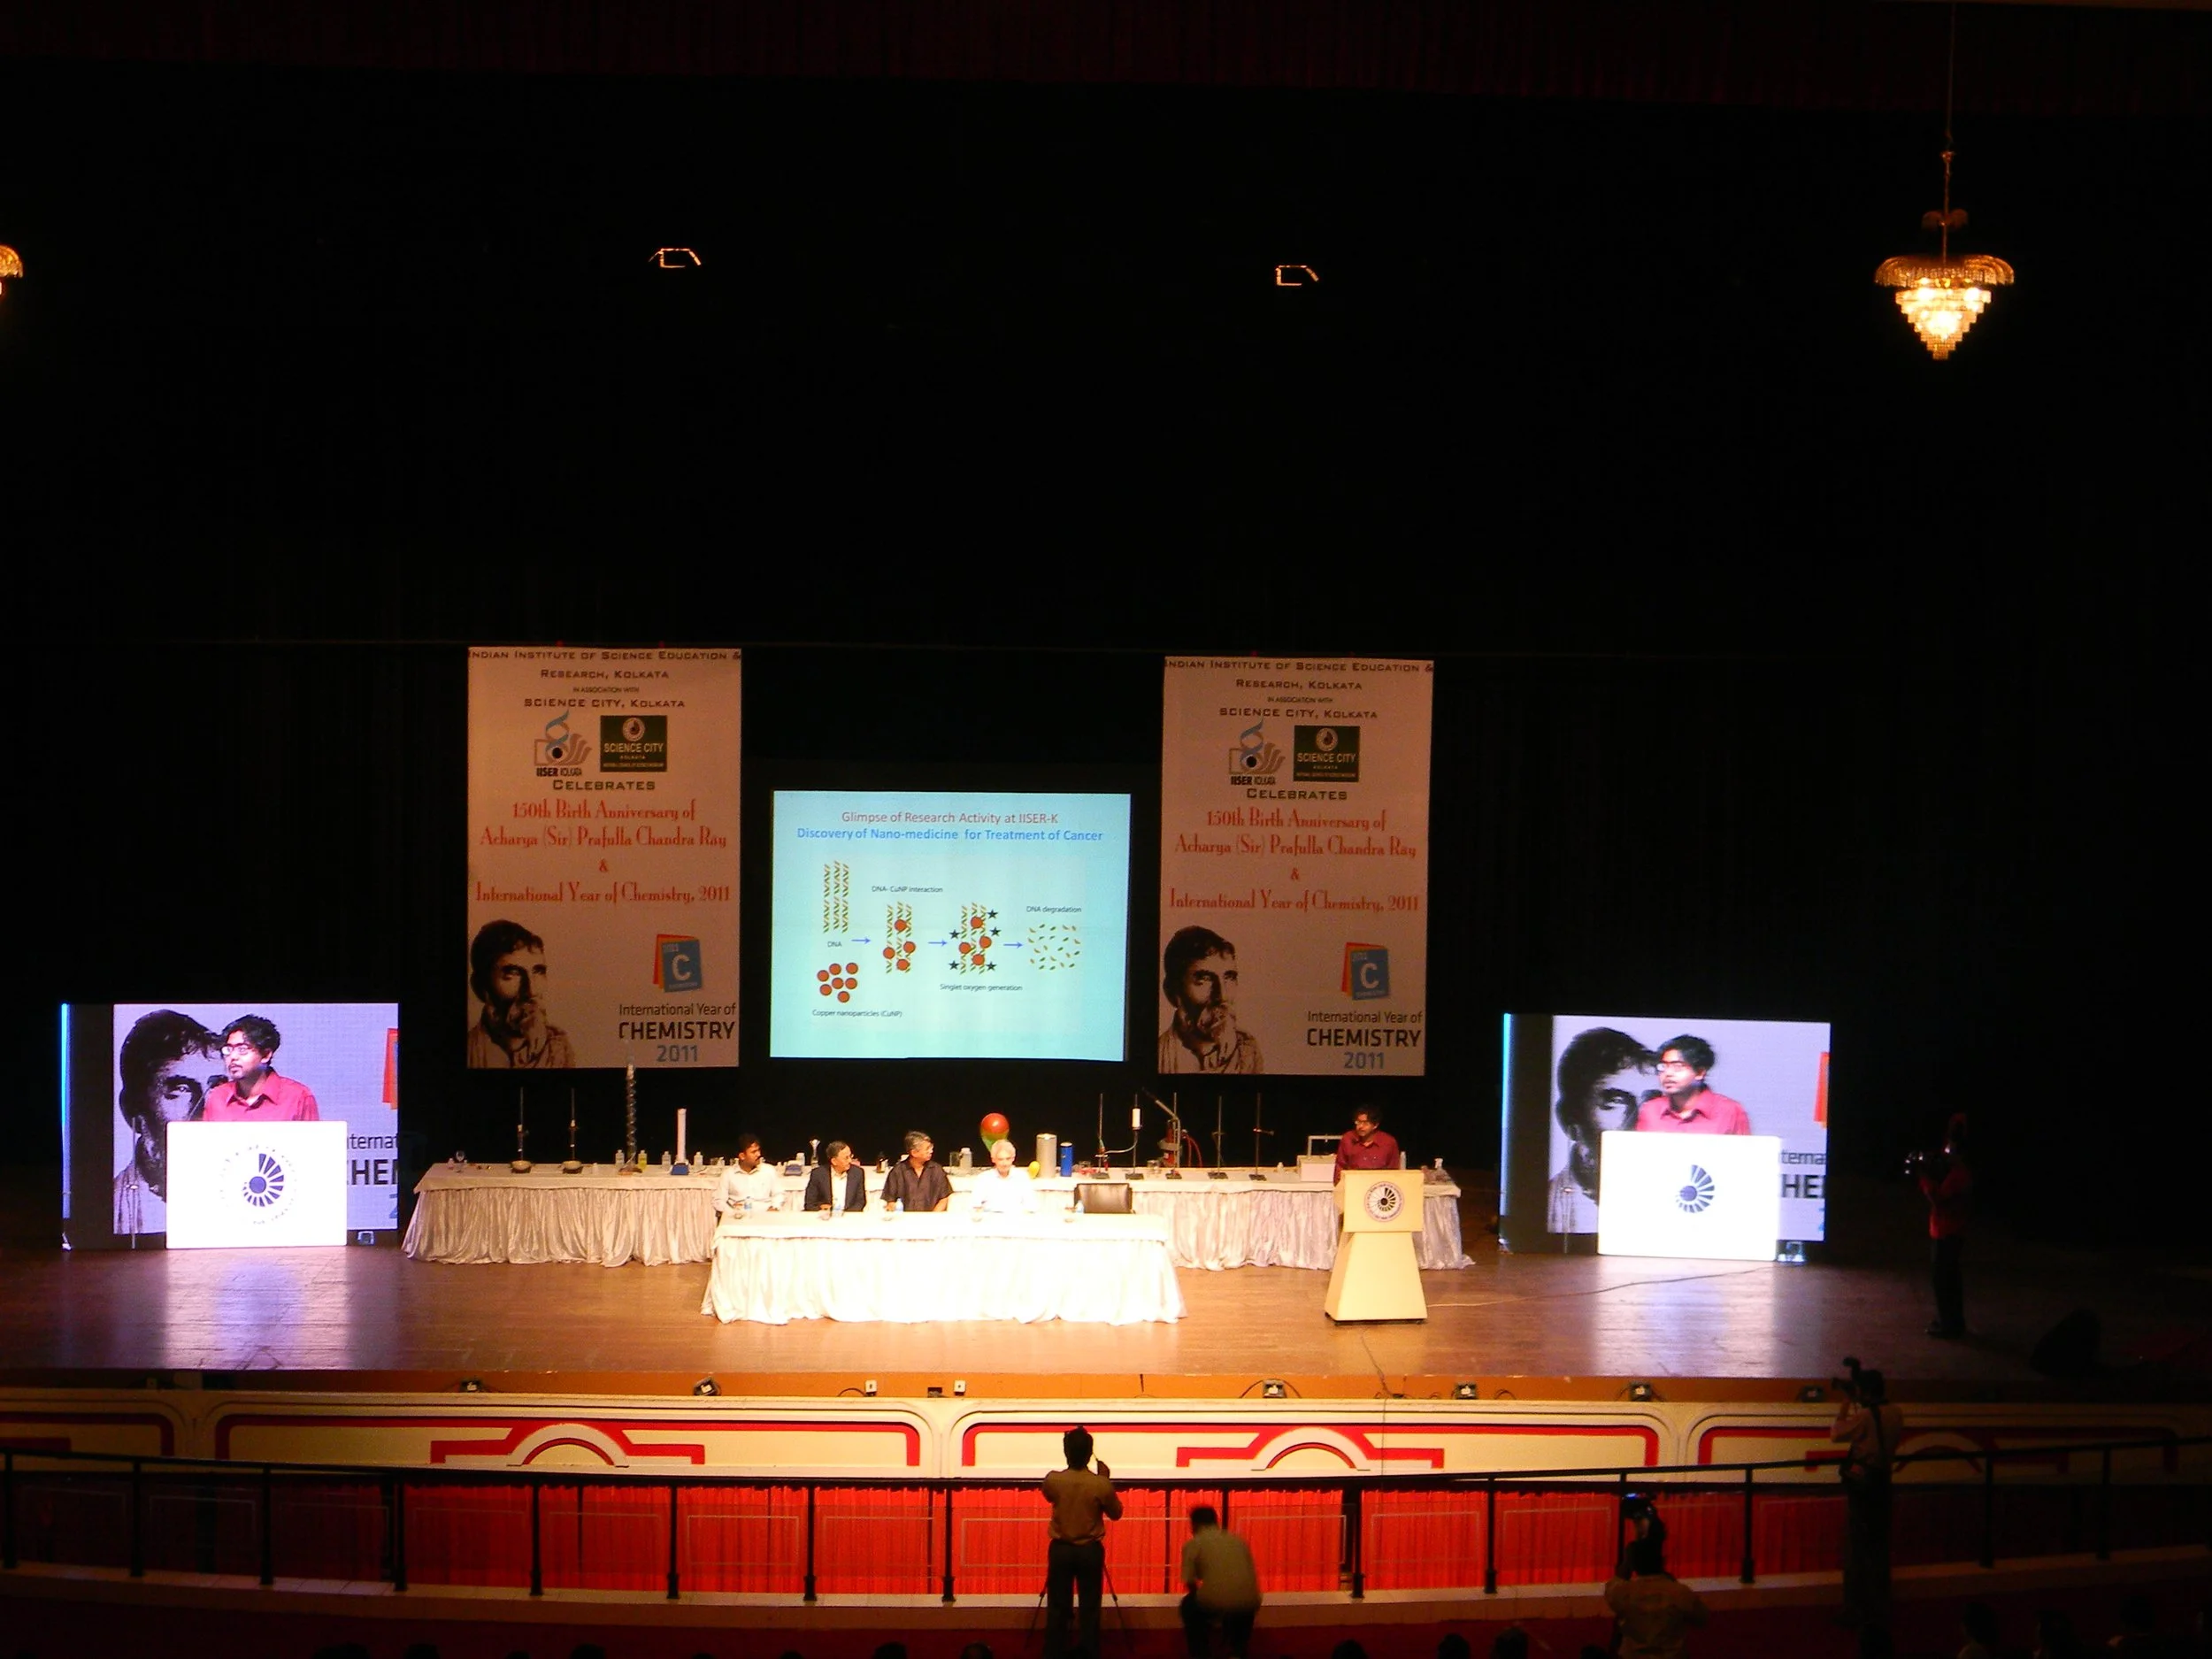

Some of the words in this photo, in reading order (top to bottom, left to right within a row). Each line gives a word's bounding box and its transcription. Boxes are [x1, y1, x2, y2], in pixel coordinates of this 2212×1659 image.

[602, 651, 652, 660] SCIENCE
[658, 651, 727, 660] EDUCATION
[1210, 660, 1271, 669] INSTITUTE
[1295, 662, 1347, 671] SCIENCE
[1352, 663, 1419, 672] EDUCATION
[614, 670, 669, 679] KOLKATA
[1309, 680, 1362, 690] KOLKATA
[524, 698, 585, 707] SCIENCE
[592, 698, 625, 708] CITY,
[631, 699, 685, 708] KOLKATA
[1219, 708, 1279, 718] SCIENCE
[1286, 709, 1318, 719] CITY,
[1324, 710, 1378, 718] KOLKATA
[603, 743, 642, 753] SCIENCE
[644, 743, 664, 753] CITY
[1297, 752, 1334, 763] SCIENCE
[1336, 753, 1356, 763] CITY
[553, 780, 656, 790] CELEBRATES
[1247, 788, 1348, 800] CELEBRATES
[512, 799, 551, 818] 150th
[556, 799, 591, 818] Birth
[595, 800, 679, 820] Anniversary
[682, 799, 695, 820] of
[842, 812, 887, 824] Glimpse
[890, 812, 902, 822] of
[905, 812, 955, 822] Research
[959, 813, 1000, 825] Activity
[1004, 814, 1016, 823] at
[1019, 814, 1057, 823] IISER-K
[1207, 807, 1244, 826] 150th
[1249, 807, 1283, 827] Birth
[1287, 809, 1369, 831] Anniversary
[1373, 810, 1386, 831] of
[480, 826, 537, 848] Acharya
[578, 826, 633, 848] Prafulla
[636, 826, 695, 846] Chandra
[699, 826, 726, 848] Ray
[797, 828, 853, 840] Discovery
[856, 828, 867, 839] of
[871, 828, 958, 840] Nano-medicine
[964, 829, 981, 840] for
[986, 830, 1044, 841] Treatment
[1048, 830, 1061, 841] of
[1064, 831, 1102, 841] Cancer
[1175, 833, 1231, 856] Acharya
[1270, 834, 1323, 856] Prafulla
[1328, 834, 1384, 856] Chandra
[1389, 836, 1416, 857] Ray
[599, 858, 609, 872] &
[1290, 867, 1300, 880] &
[475, 881, 563, 902] International
[568, 882, 601, 902] Year
[605, 882, 618, 903] of
[699, 886, 730, 902] 2011
[1170, 887, 1255, 909] International
[1260, 889, 1291, 909] Year
[1295, 889, 1310, 911] of
[1388, 895, 1419, 910] 2011
[672, 954, 691, 980] C
[1361, 963, 1379, 988] C
[619, 1002, 694, 1016] International
[696, 1002, 721, 1015] Year
[724, 1002, 736, 1016] of
[1308, 1010, 1380, 1023] International
[1384, 1011, 1408, 1023] Year
[1411, 1010, 1423, 1024] of
[618, 1021, 735, 1040] CHEMISTRY
[1307, 1027, 1421, 1047] CHEMISTRY
[657, 1045, 698, 1062] 2011
[1344, 1051, 1384, 1069] 2011
